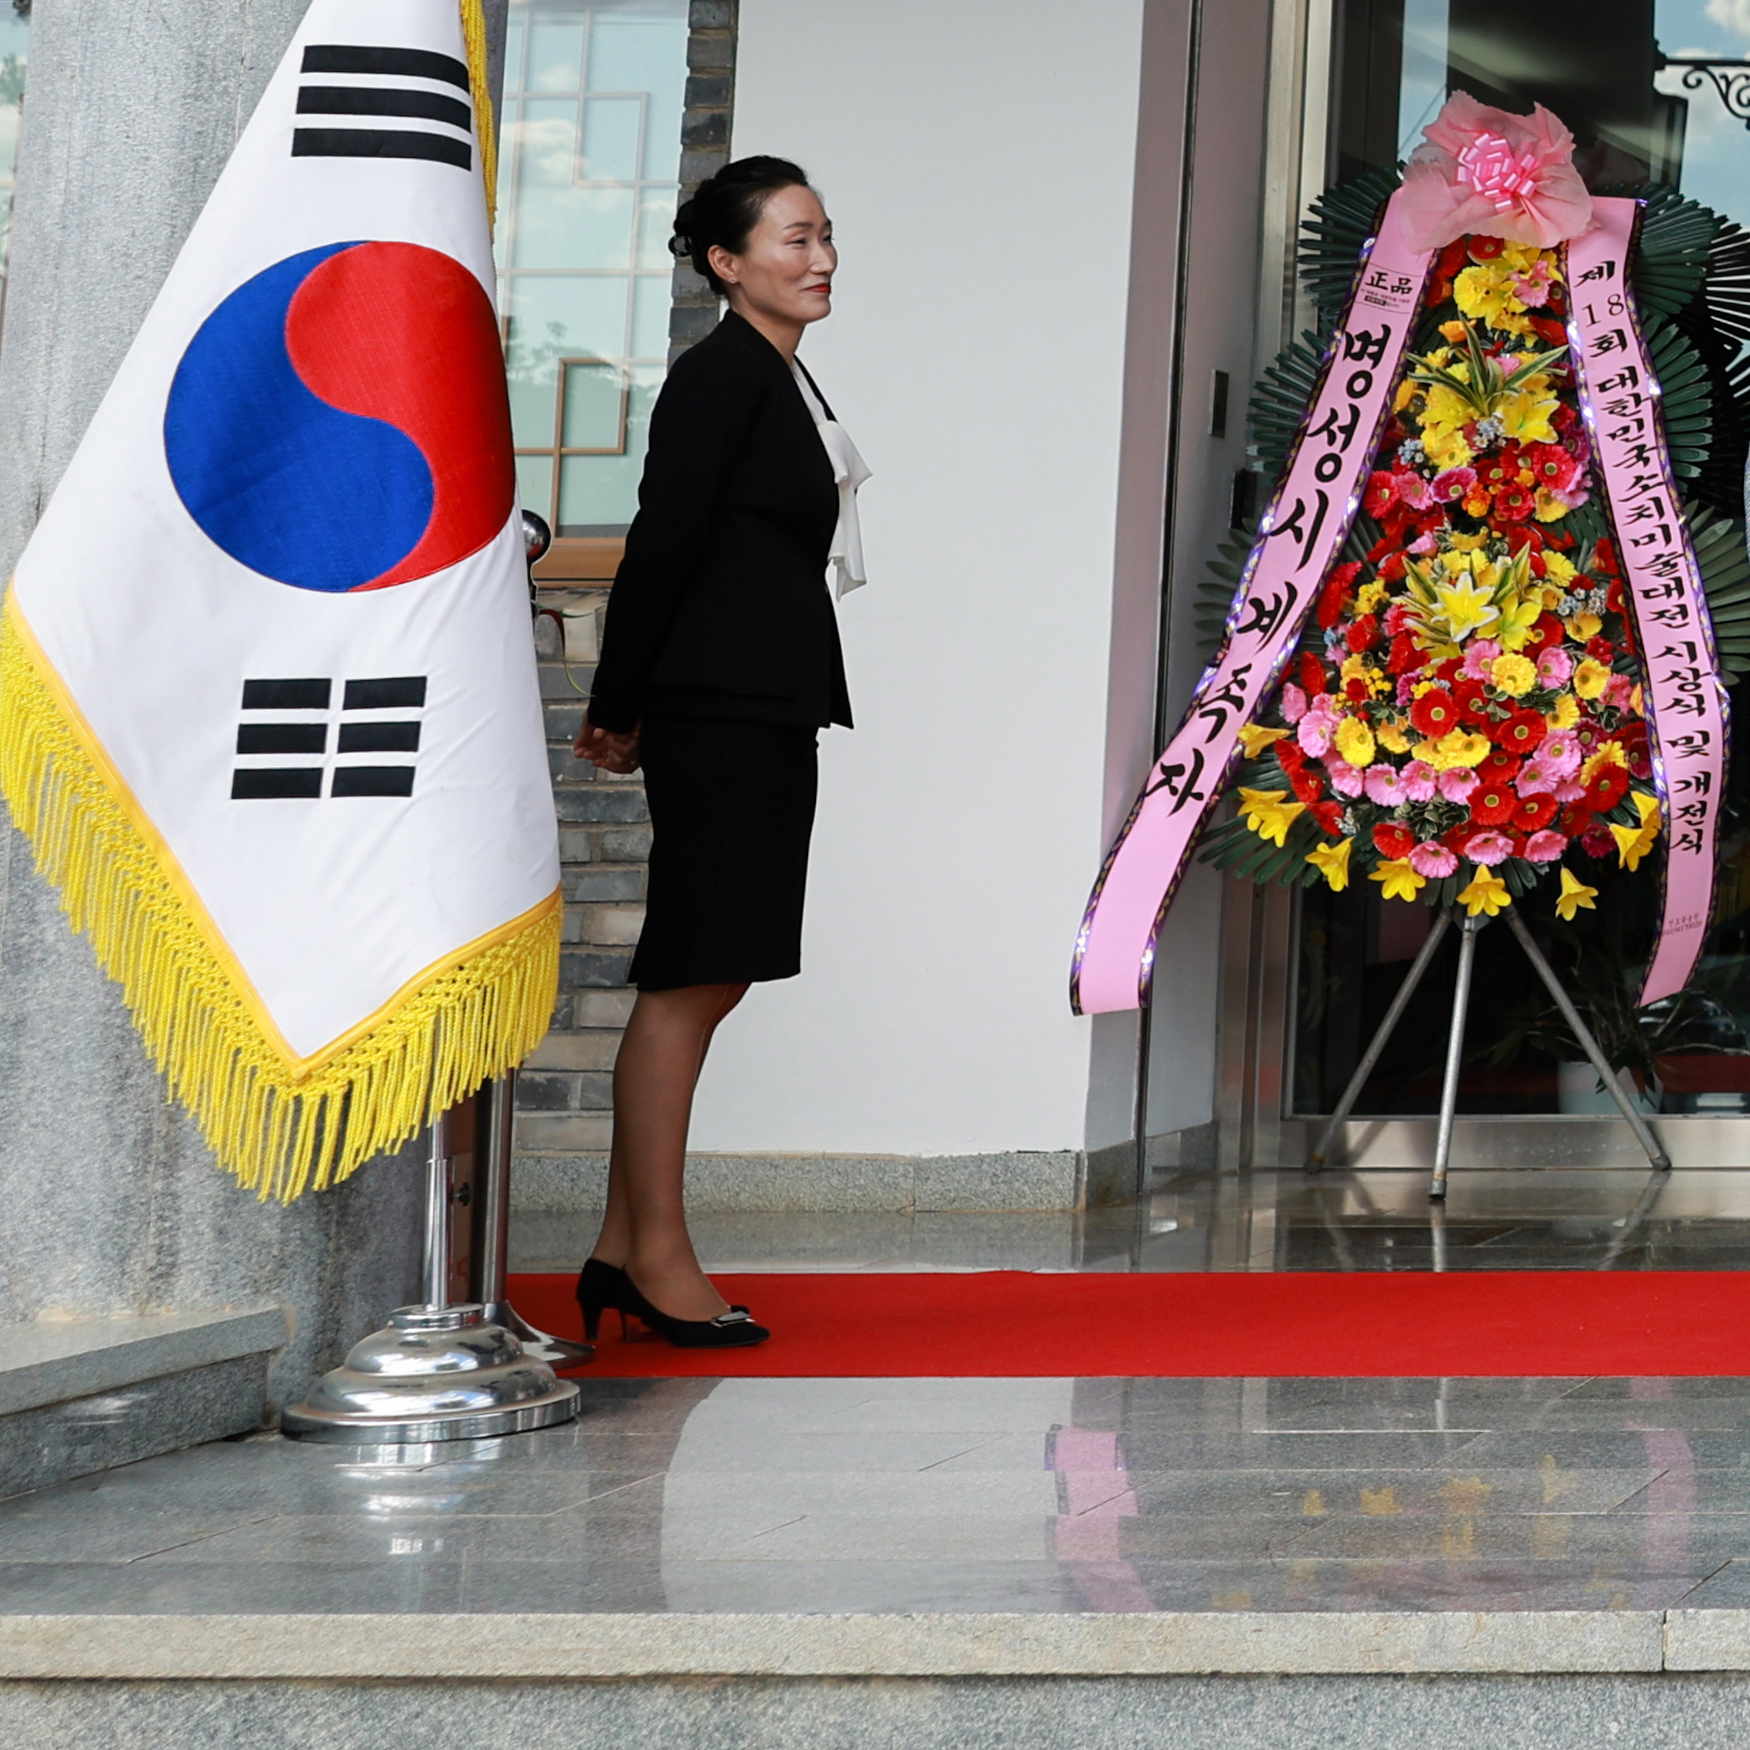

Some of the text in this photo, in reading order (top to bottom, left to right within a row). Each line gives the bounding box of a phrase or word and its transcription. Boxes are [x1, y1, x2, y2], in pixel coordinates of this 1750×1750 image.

[1364, 271, 1413, 296] 正品
[1573, 260, 1628, 359] 제18회
[1594, 365, 1690, 629] 대한민국소치미술대전
[1651, 640, 1711, 718] 시상식
[1664, 730, 1711, 759] 및
[1669, 770, 1712, 856] 개전식
